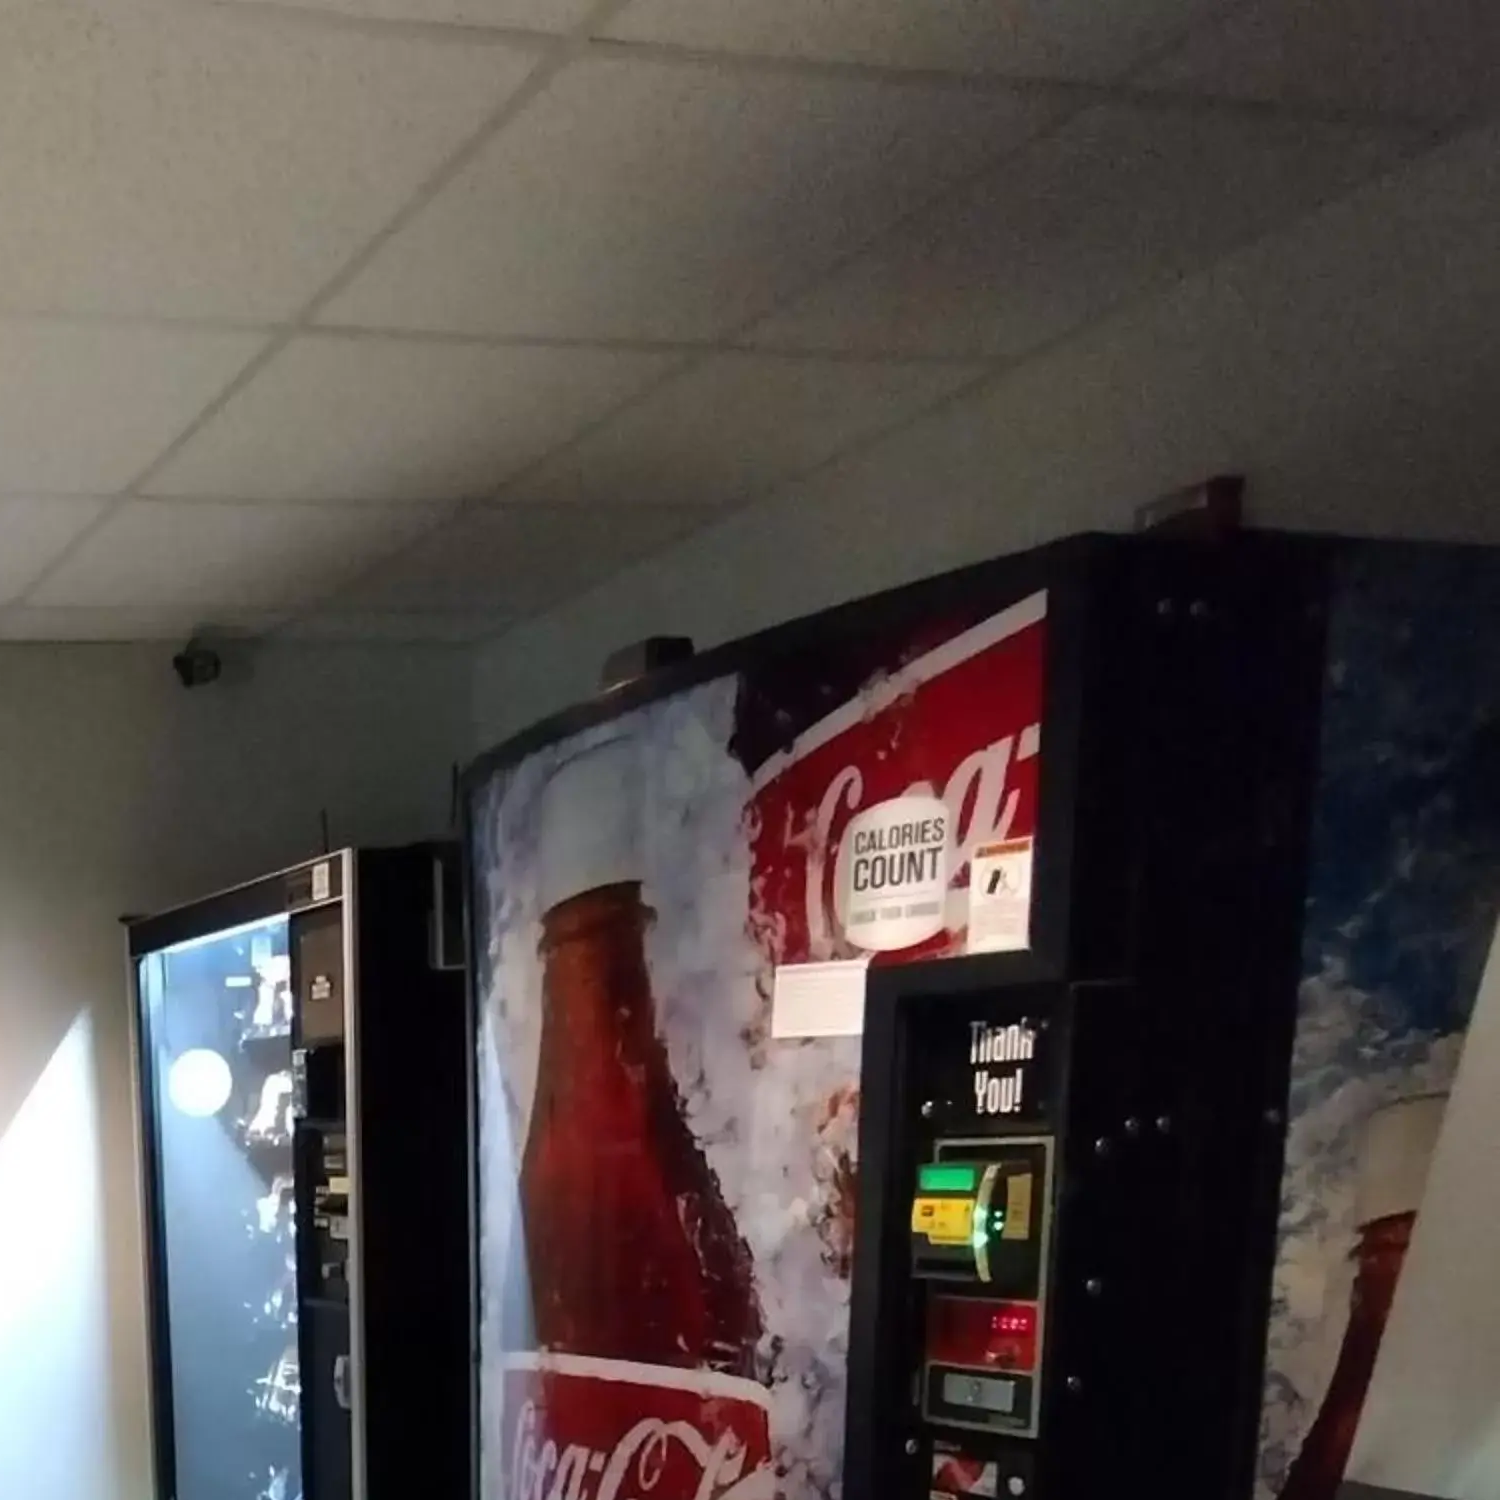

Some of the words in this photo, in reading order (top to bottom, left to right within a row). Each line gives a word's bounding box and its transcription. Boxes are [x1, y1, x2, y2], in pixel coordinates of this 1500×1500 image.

[853, 816, 946, 856] CALORIES
[852, 845, 943, 892] COUNT
[969, 1016, 1038, 1065] Thank
[974, 1067, 1024, 1115] You!
